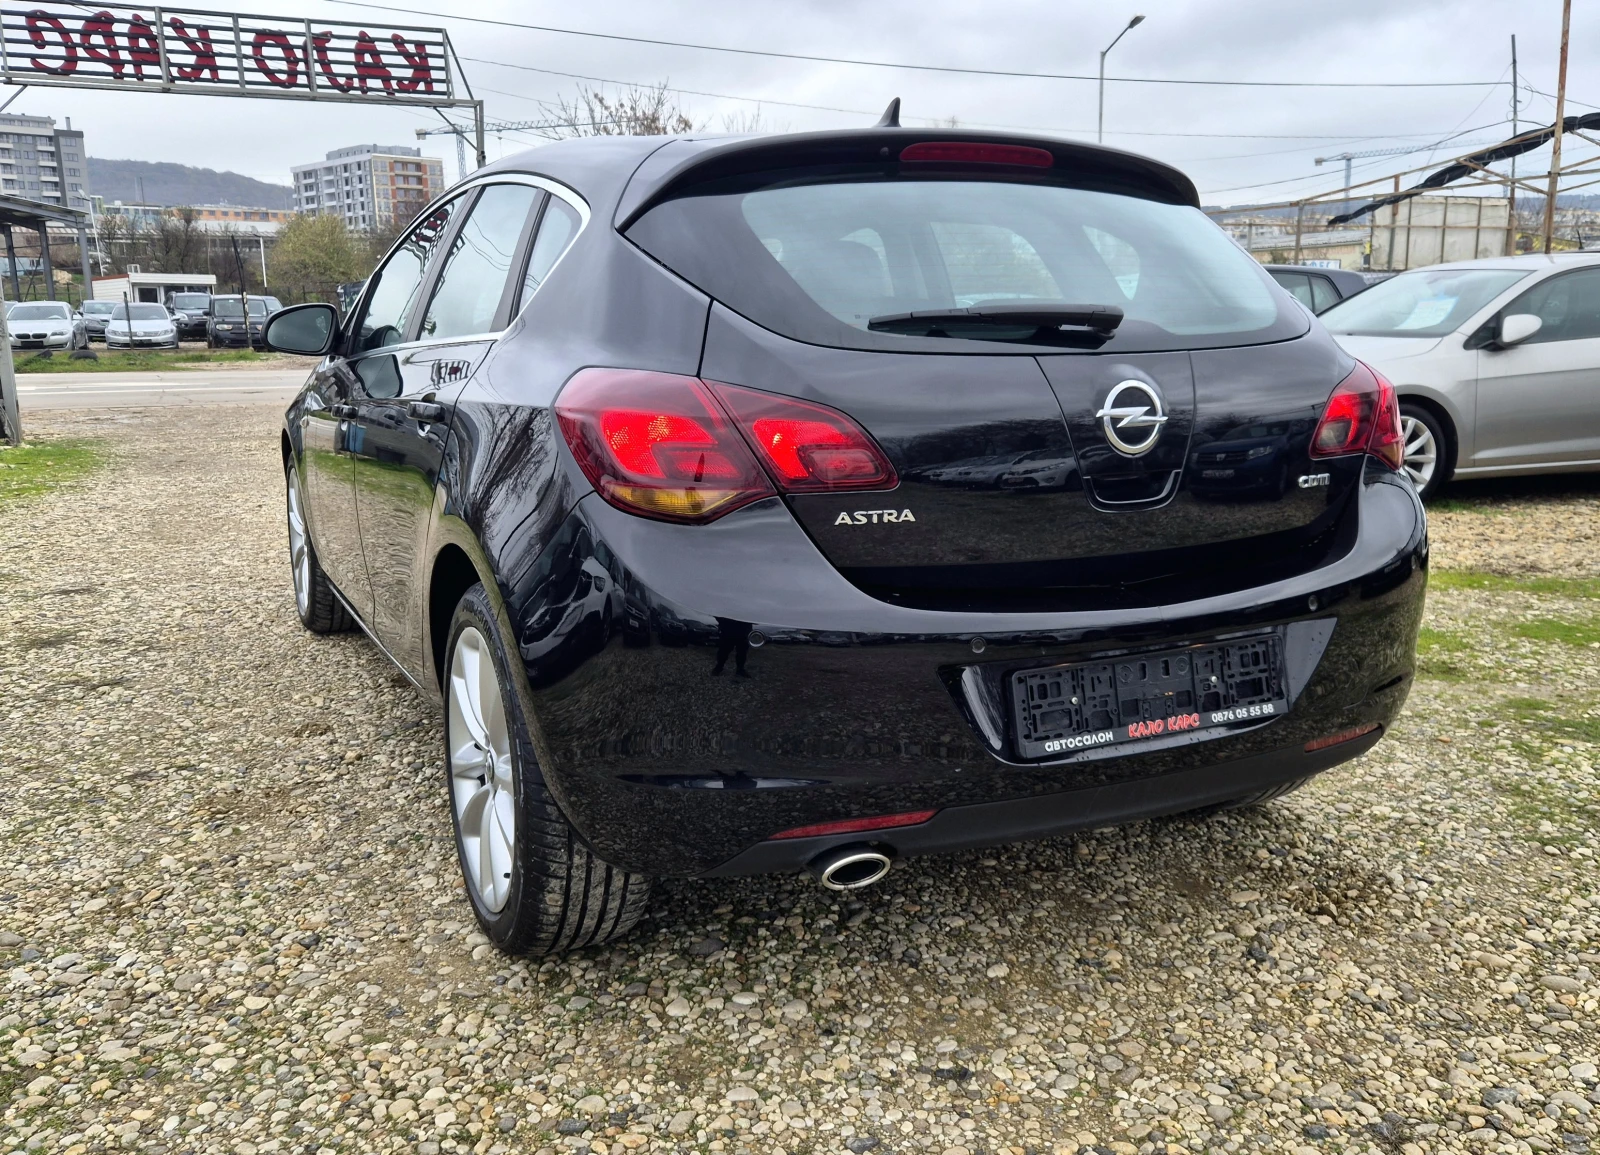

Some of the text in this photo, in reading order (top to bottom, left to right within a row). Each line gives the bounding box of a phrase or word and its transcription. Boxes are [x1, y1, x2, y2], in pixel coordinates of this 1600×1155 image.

[834, 508, 916, 526] ASTRA
[1128, 718, 1164, 738] КАЛО
[1167, 712, 1200, 732] КАРС
[1211, 708, 1234, 723] 0876
[1236, 707, 1248, 719] 05
[1249, 705, 1261, 717] 55
[1262, 703, 1274, 715] 88
